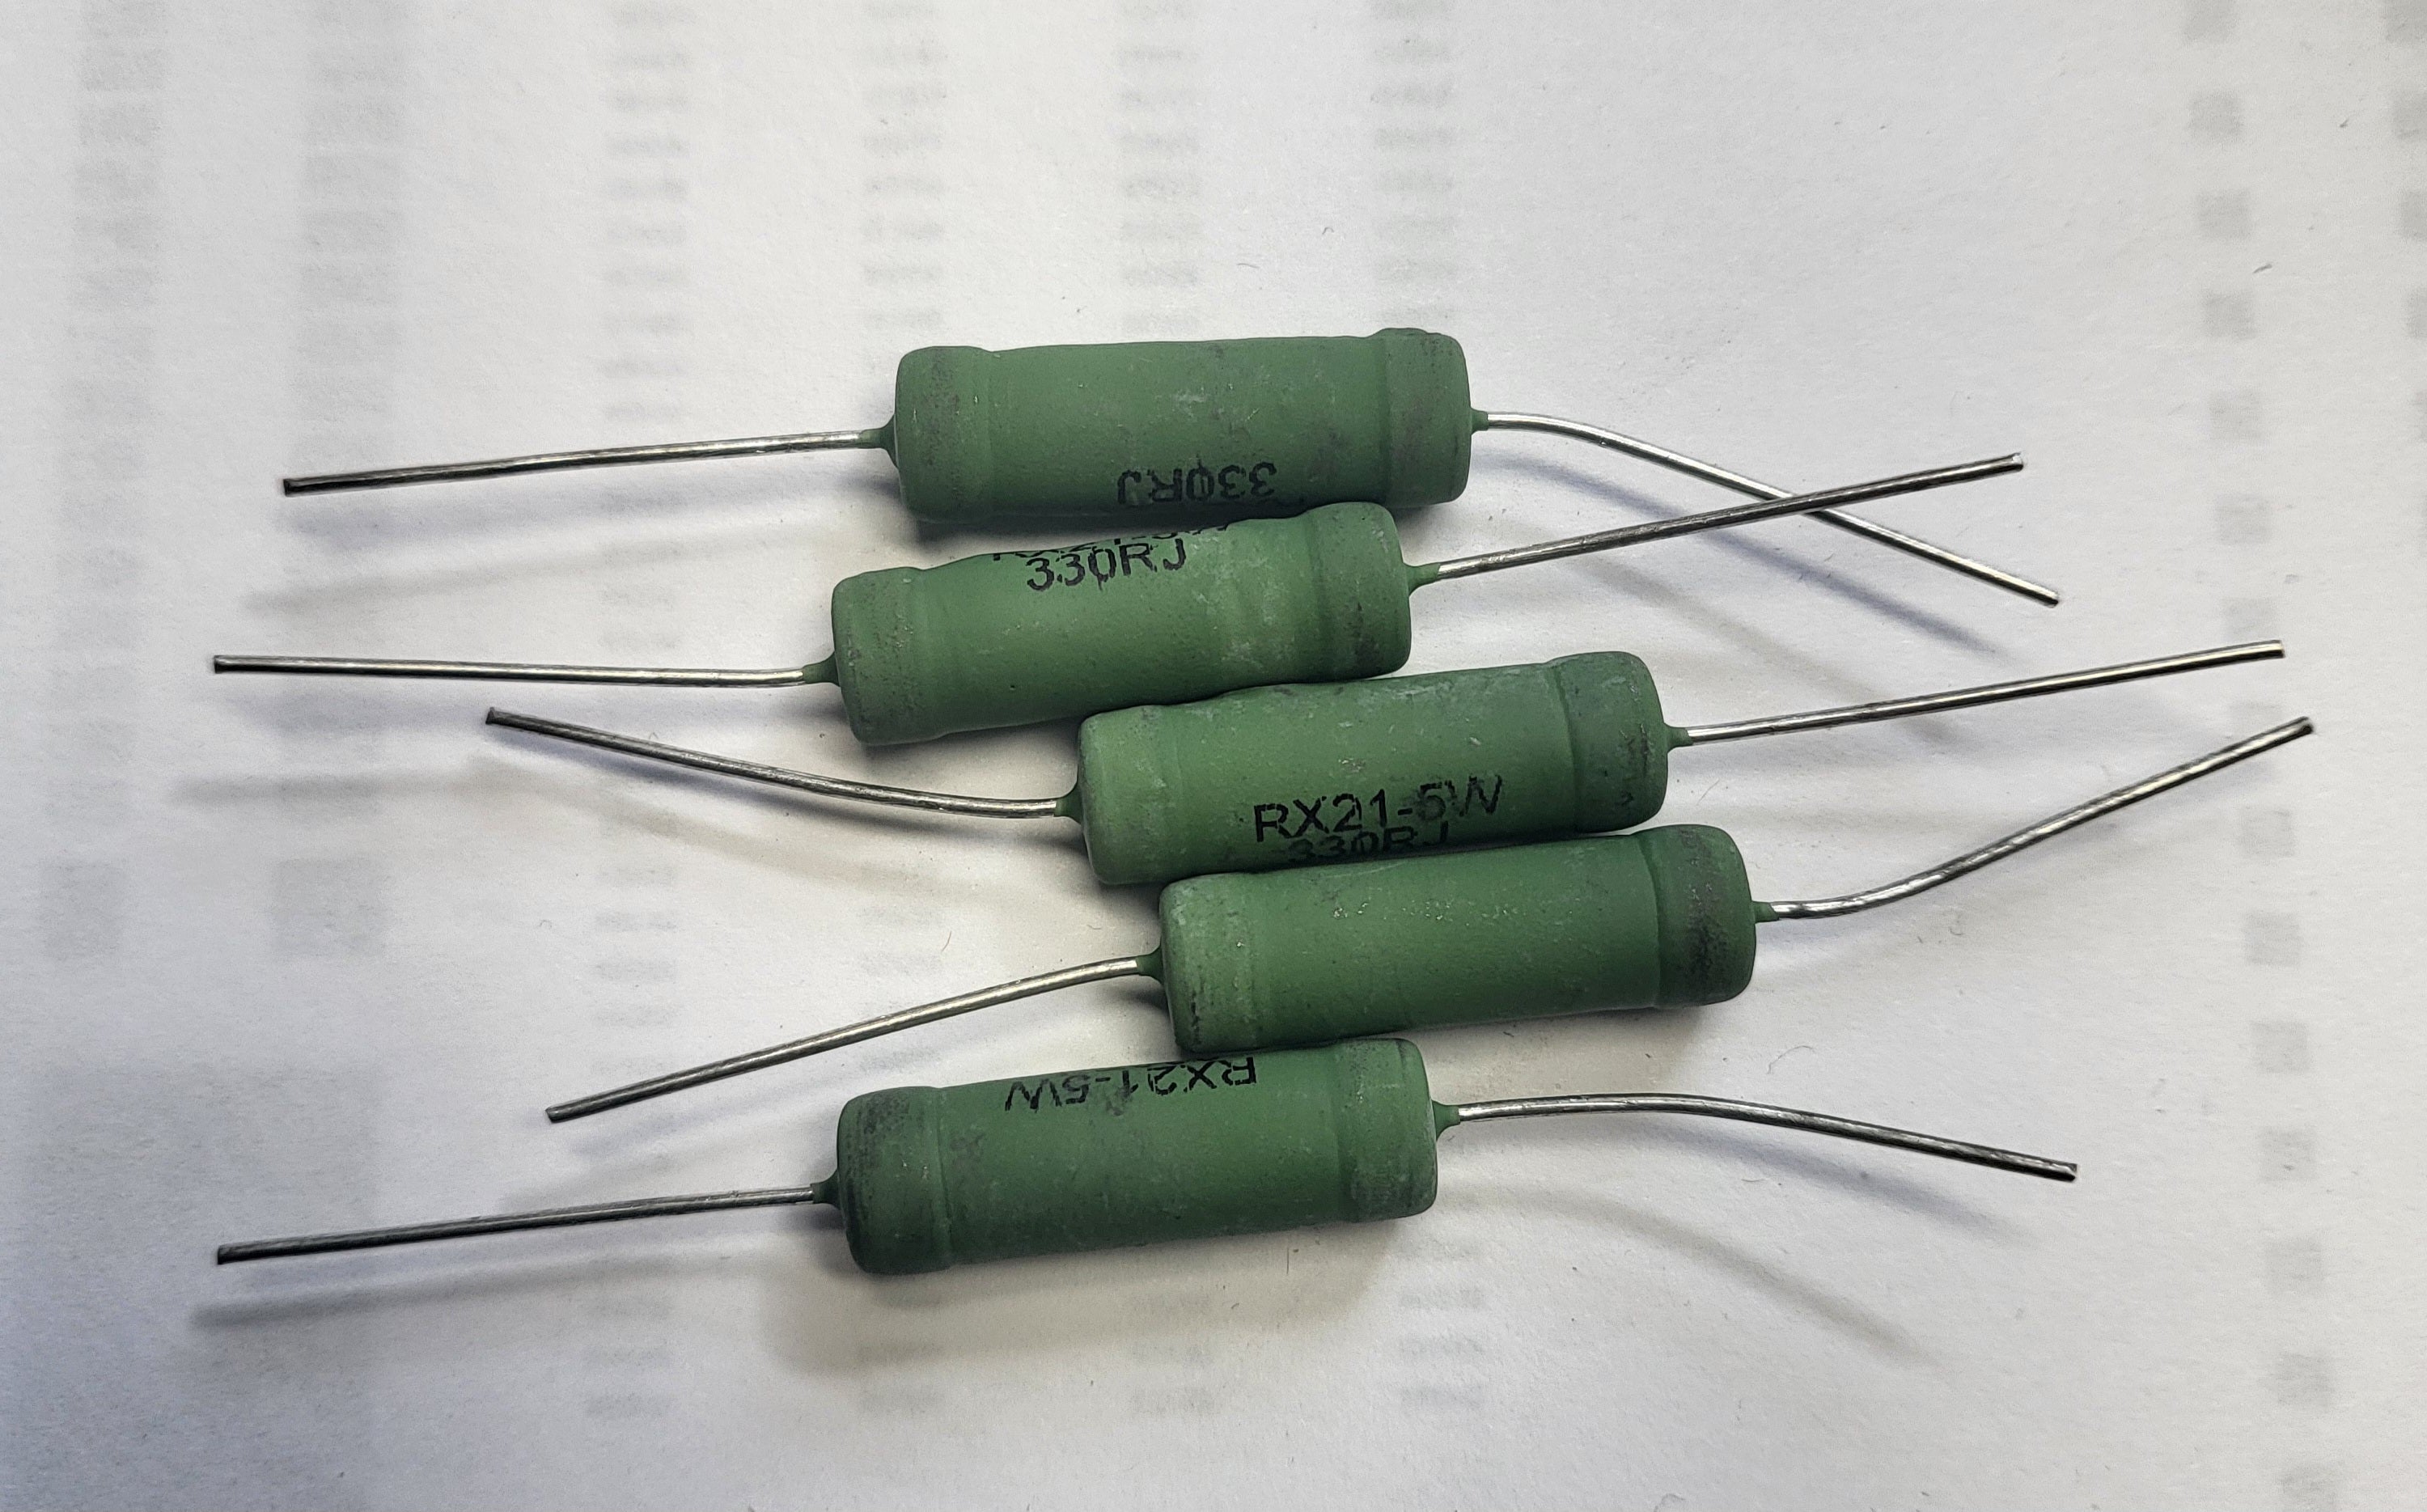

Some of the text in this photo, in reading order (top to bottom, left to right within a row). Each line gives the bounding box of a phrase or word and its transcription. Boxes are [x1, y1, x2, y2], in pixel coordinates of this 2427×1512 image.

[1117, 460, 1277, 504] 330RJ
[1026, 538, 1186, 591] 330RJ
[1254, 774, 1502, 842] RX21-5W
[1005, 1057, 1256, 1112] RX21-5W
